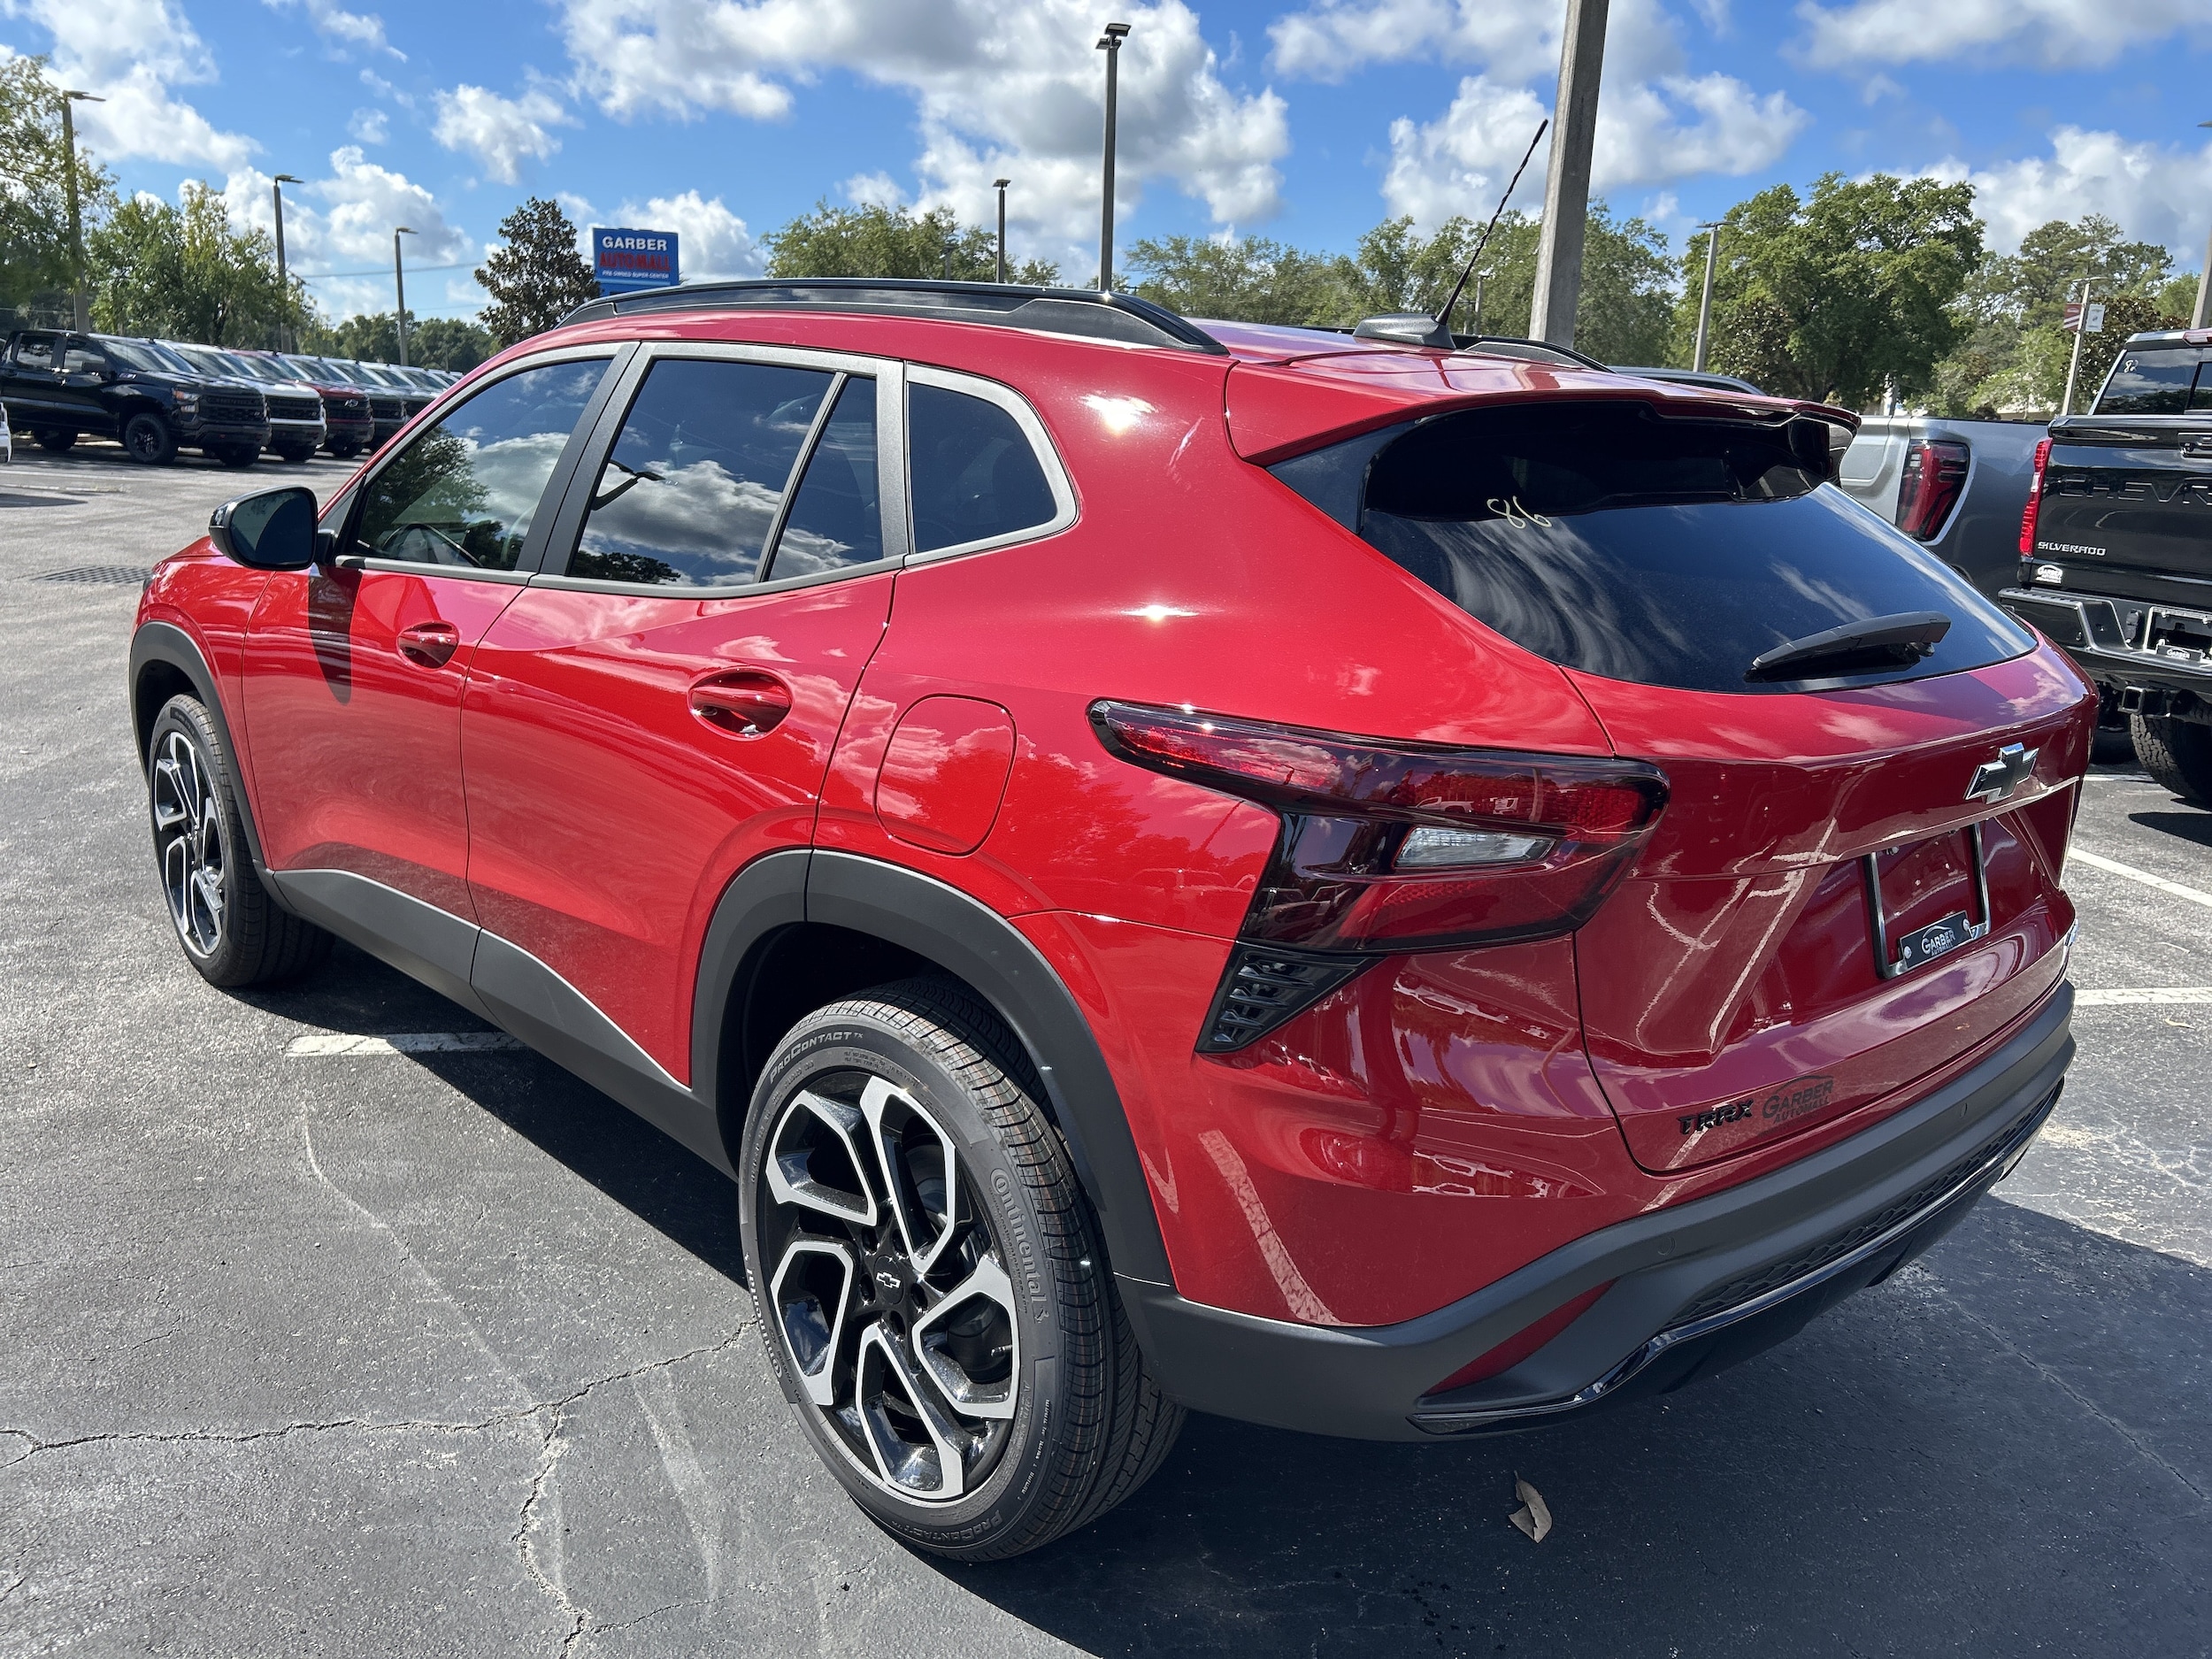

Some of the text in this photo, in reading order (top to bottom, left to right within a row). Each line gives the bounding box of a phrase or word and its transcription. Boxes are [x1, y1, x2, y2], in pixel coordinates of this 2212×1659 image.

[602, 235, 668, 251] GARBER
[599, 251, 671, 272] AUTOMALL
[1486, 495, 1553, 529] 86
[2037, 541, 2107, 557] SILVERADO
[1921, 929, 1956, 955] GARBER
[1931, 941, 1953, 956] AUTOMALL
[1762, 1079, 1834, 1119] GARBER
[1772, 1095, 1831, 1125] AUTOMALL
[1676, 1098, 1755, 1135] TRAX
[990, 1167, 1048, 1303] Continental
